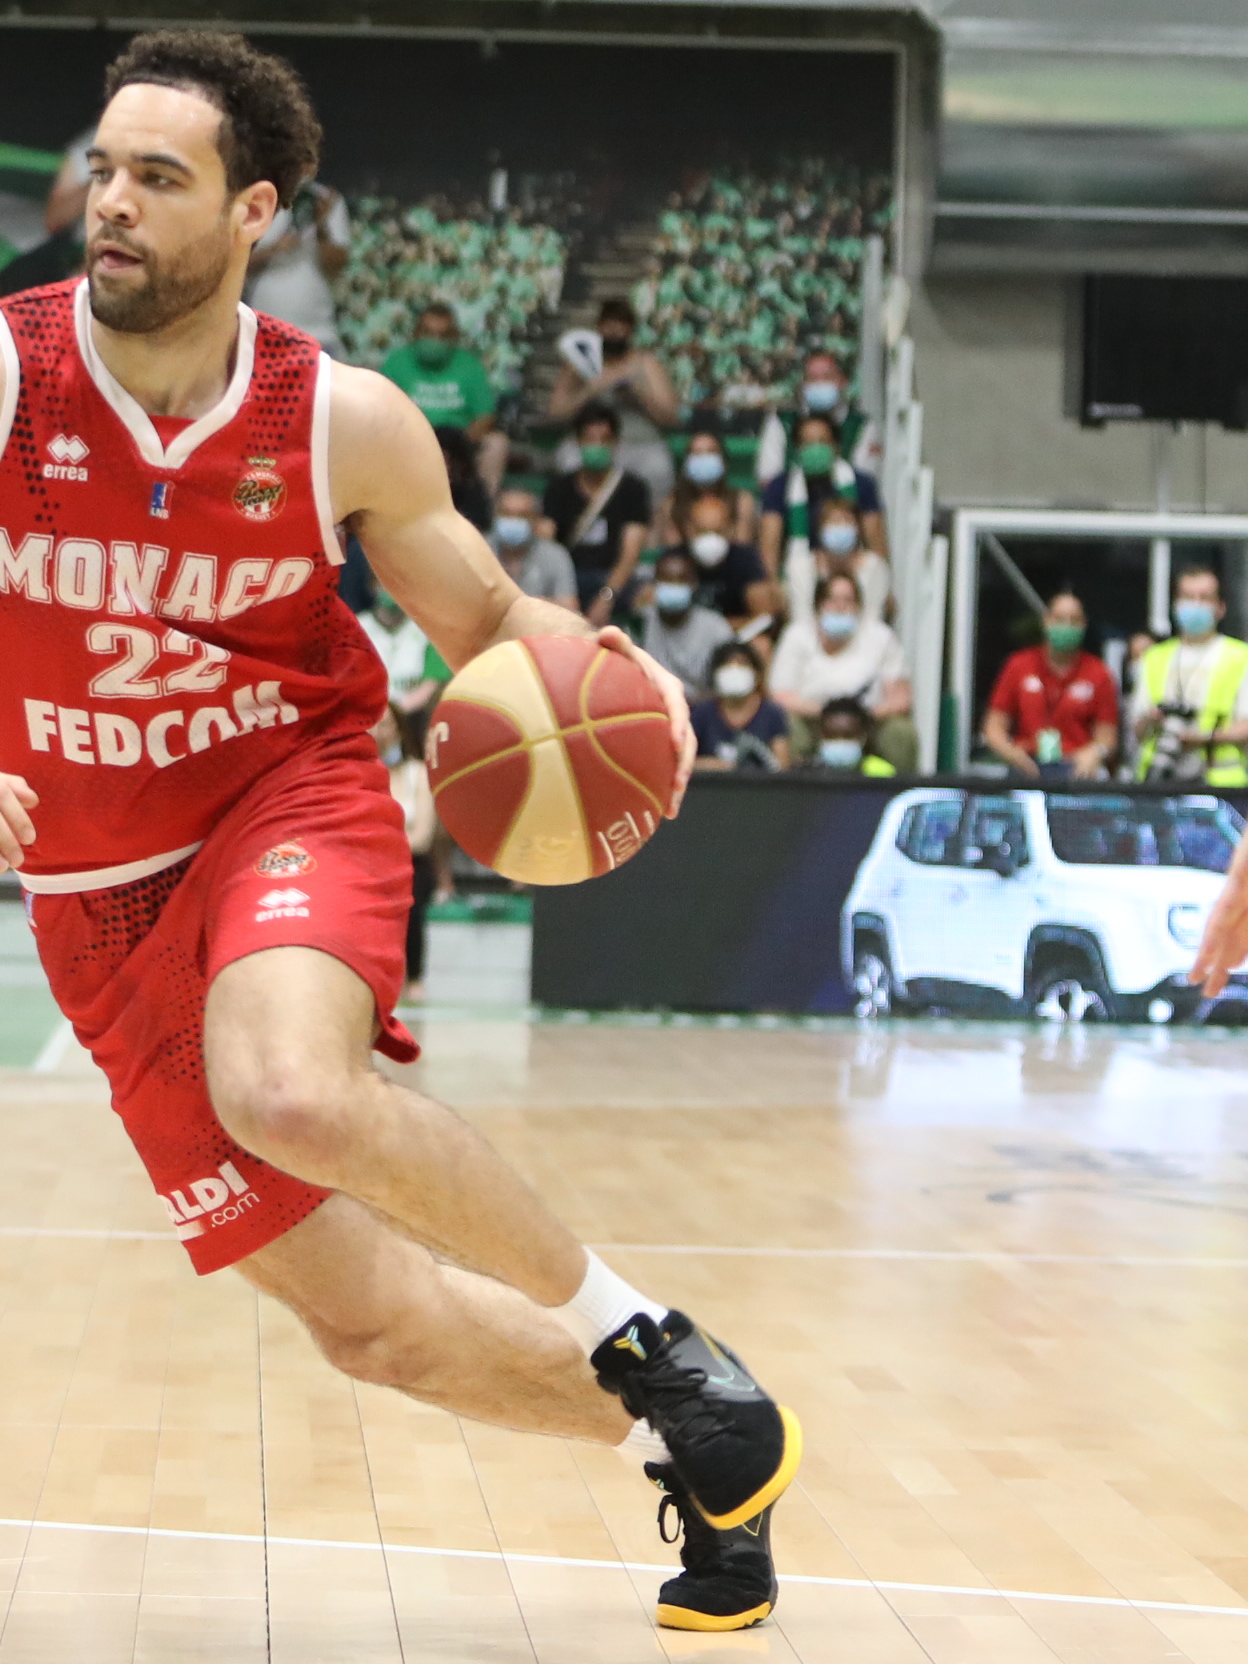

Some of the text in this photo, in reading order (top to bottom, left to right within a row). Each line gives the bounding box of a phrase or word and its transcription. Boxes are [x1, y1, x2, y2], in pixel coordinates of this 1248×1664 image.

[43, 463, 88, 482] errea
[87, 623, 231, 698] 22
[23, 681, 300, 768] FEDCOM
[211, 1192, 261, 1228] .com
